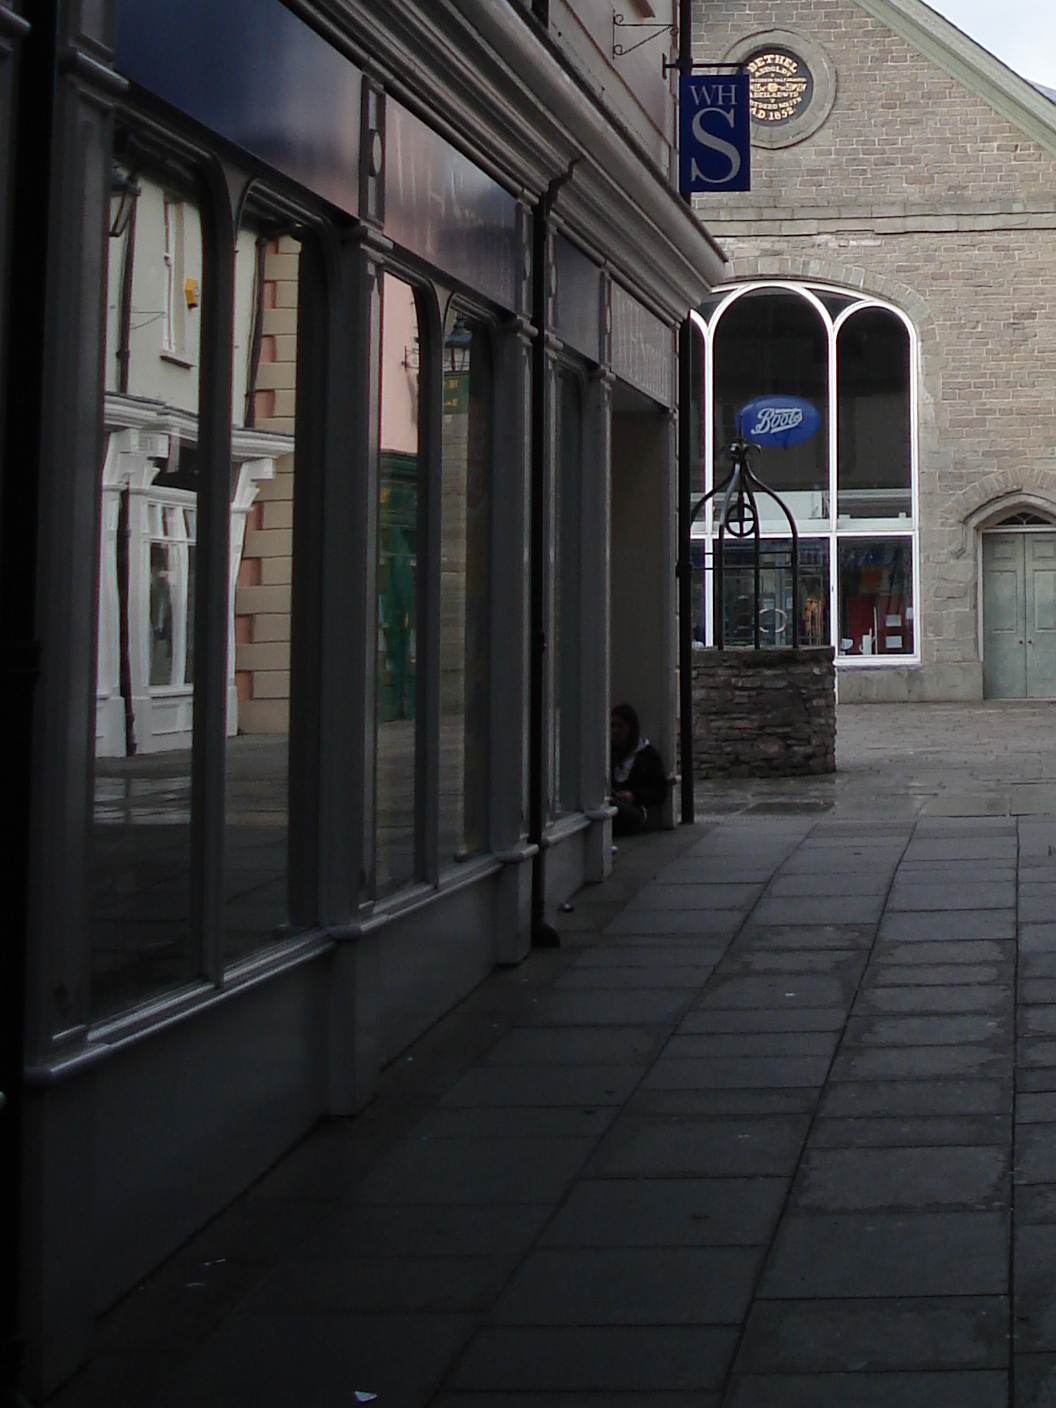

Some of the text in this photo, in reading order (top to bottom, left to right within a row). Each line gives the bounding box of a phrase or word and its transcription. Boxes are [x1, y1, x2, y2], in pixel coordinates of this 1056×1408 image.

[746, 54, 798, 73] BETHEL
[689, 84, 738, 106] WH
[691, 107, 741, 184] S
[751, 408, 803, 435] Boots
